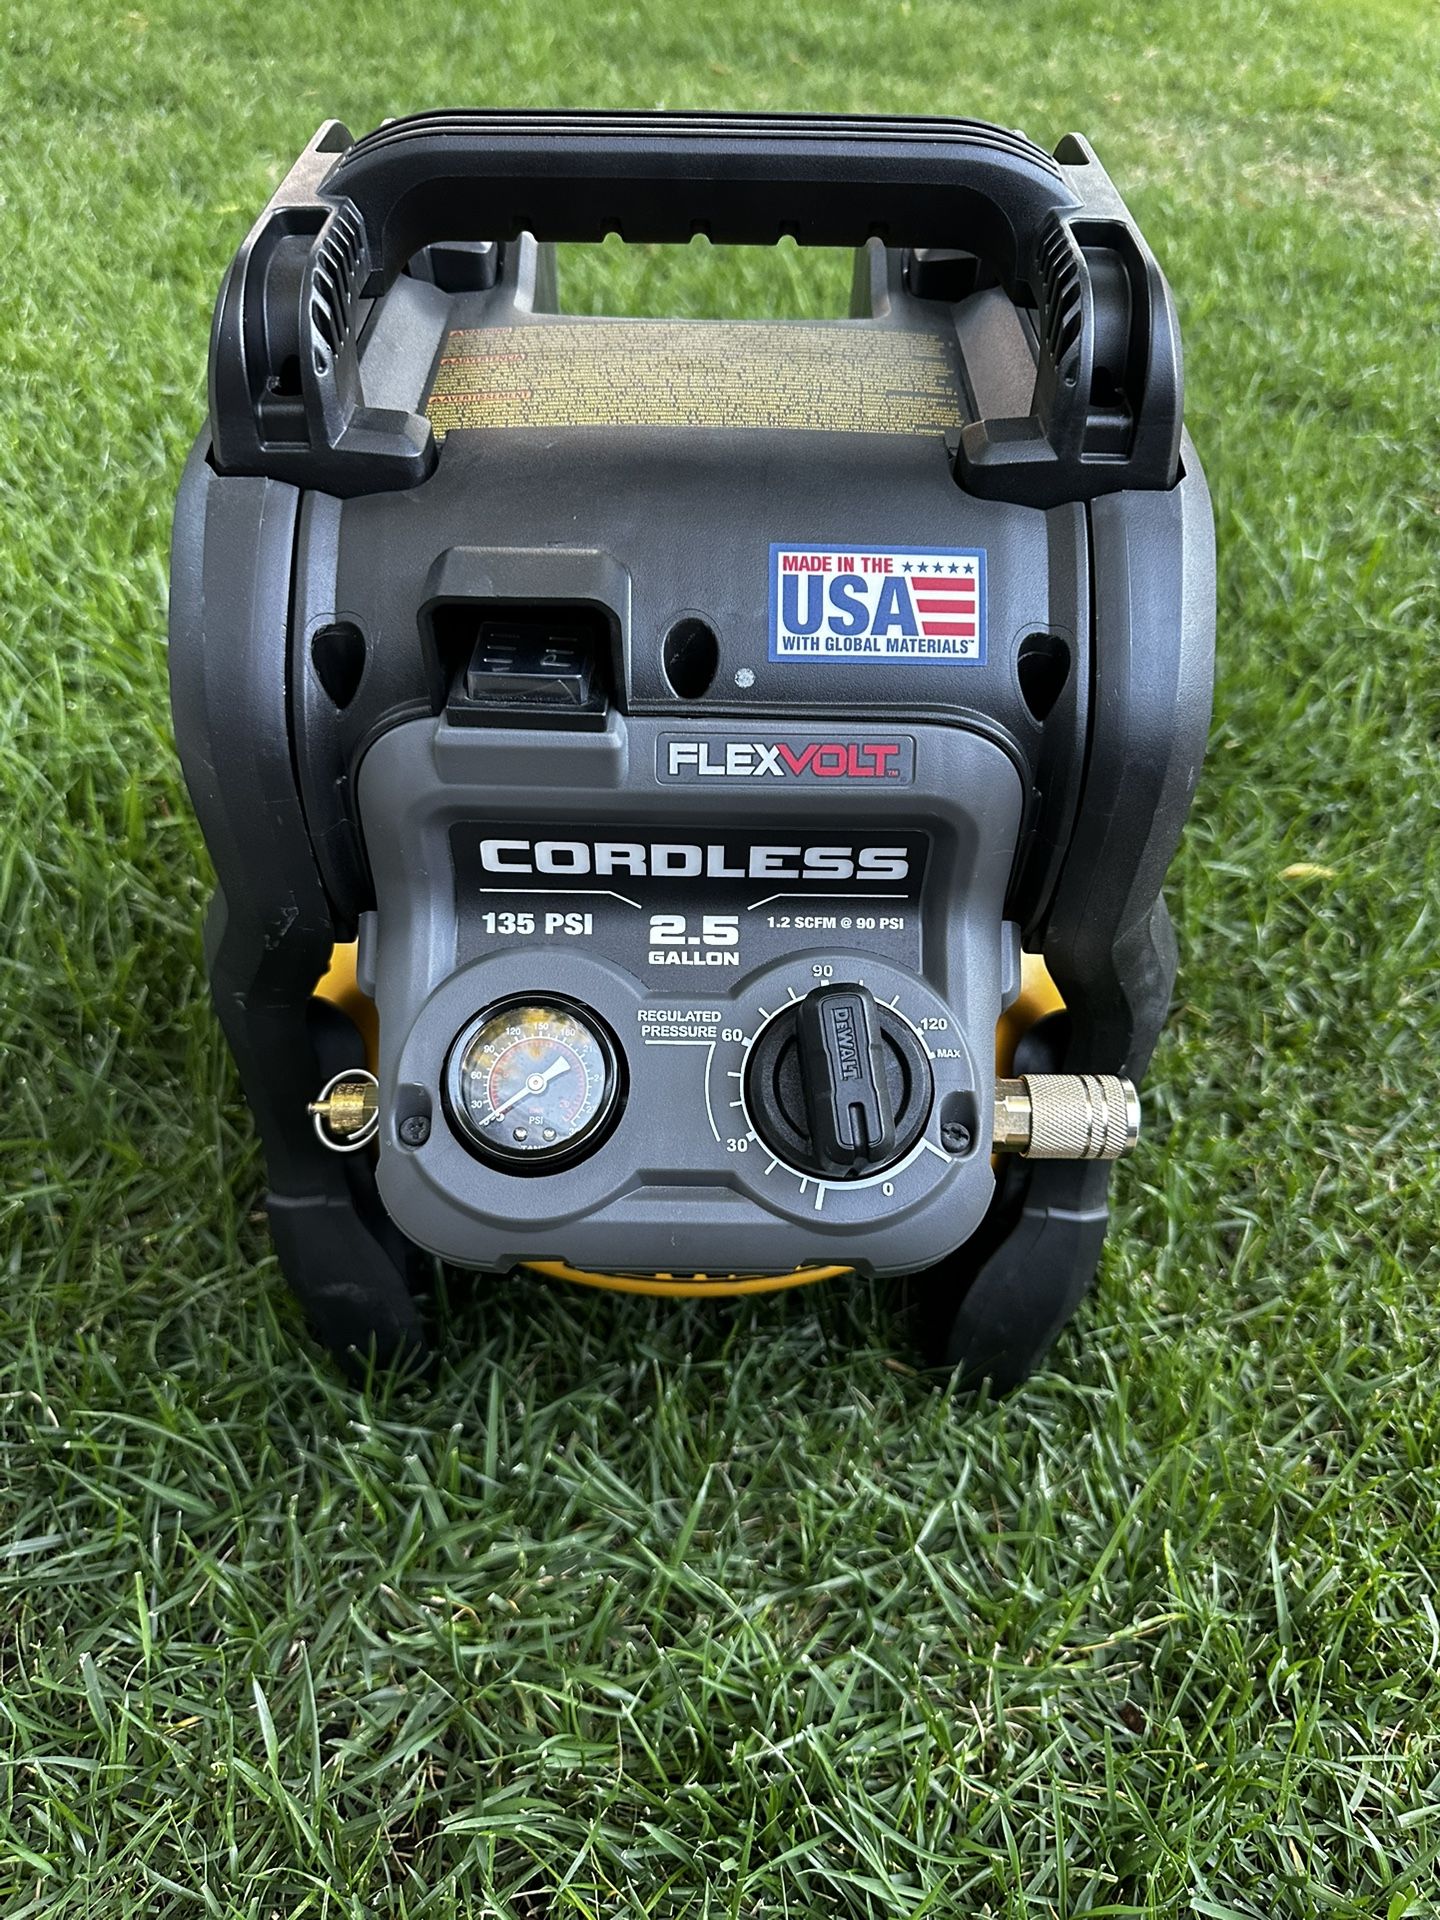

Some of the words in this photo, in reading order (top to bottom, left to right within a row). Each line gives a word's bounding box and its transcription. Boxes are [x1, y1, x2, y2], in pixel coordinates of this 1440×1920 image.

[442, 391, 529, 402] AVERTISSEMENT
[783, 556, 832, 572] MADE
[838, 557, 854, 572] IN
[861, 557, 893, 573] THE
[783, 574, 919, 636] USA
[782, 636, 820, 650] WITH
[825, 637, 880, 651] GLOBAL
[479, 839, 909, 880] CORDLESS
[481, 912, 535, 935] 135
[545, 912, 593, 935] PSI
[767, 916, 790, 929] 1.2
[794, 916, 836, 930] SCFM
[841, 917, 852, 929] @
[856, 917, 876, 930] 90
[879, 917, 904, 930] PSI
[649, 914, 739, 946] 2.5
[648, 951, 740, 966] GALLON
[812, 965, 833, 977] 90
[637, 1009, 722, 1022] REGULATED
[534, 1023, 549, 1031] 150
[920, 1018, 948, 1031] 120
[506, 1027, 521, 1036] 120
[641, 1025, 717, 1038] PRESSURE
[721, 1028, 743, 1041] 60
[483, 1045, 495, 1053] 90
[937, 1049, 961, 1058] MAX
[471, 1071, 482, 1079] 60
[471, 1101, 483, 1109] 30
[529, 1116, 543, 1125] PSI
[726, 1139, 748, 1152] 30
[882, 1183, 894, 1196] 0
